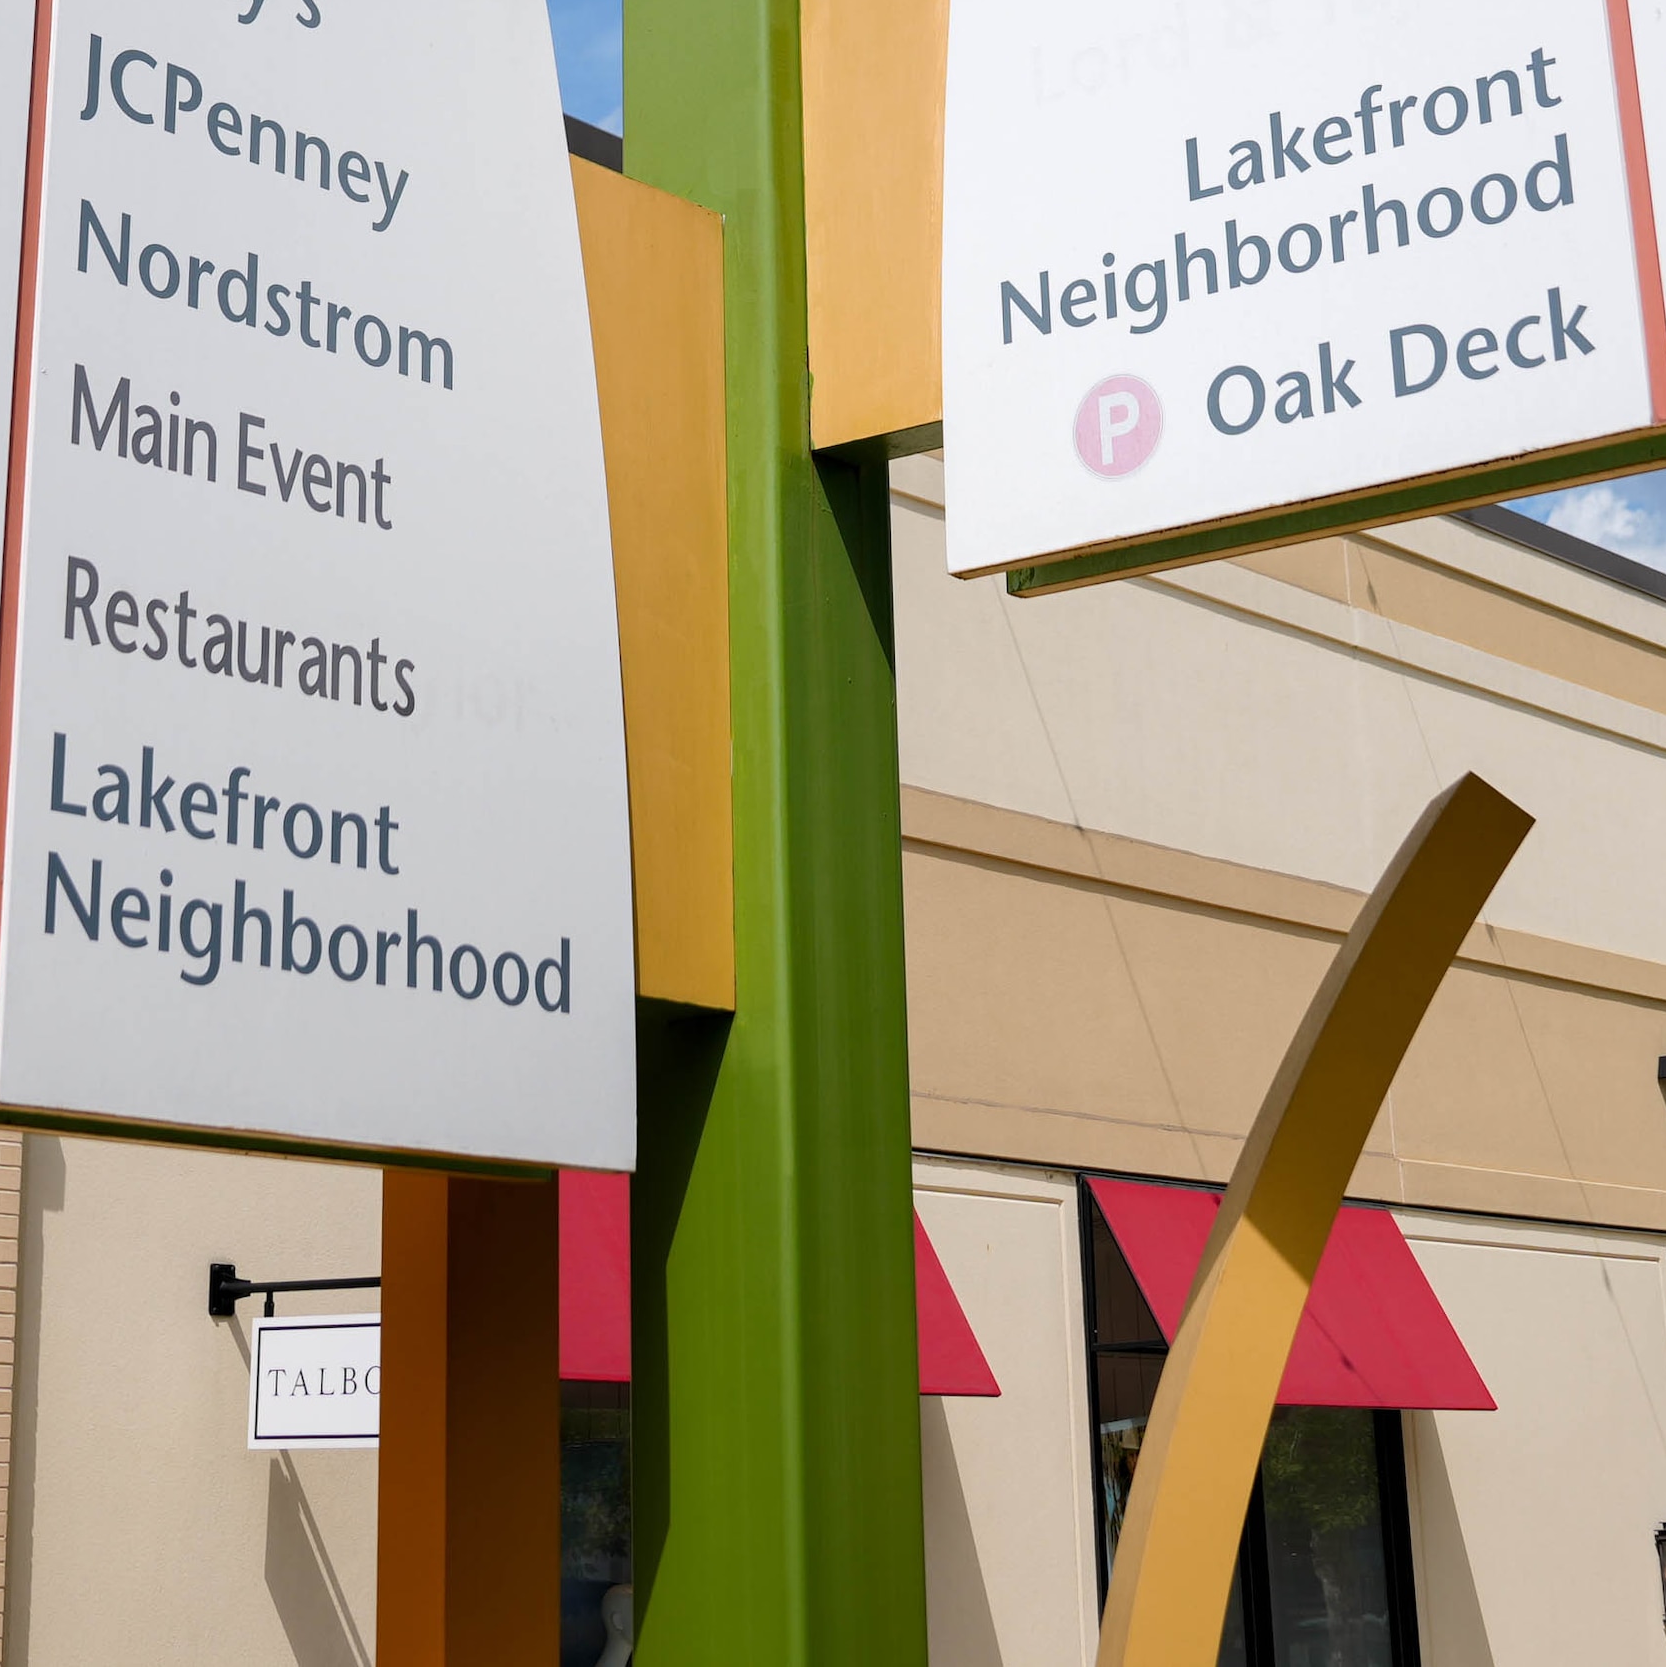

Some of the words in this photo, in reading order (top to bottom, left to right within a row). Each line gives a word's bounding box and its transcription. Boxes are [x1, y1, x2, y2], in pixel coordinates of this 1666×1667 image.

[79, 33, 410, 233] JCPenney
[1185, 46, 1563, 202] Lakefront
[77, 198, 454, 391] Nordstrom
[1000, 132, 1575, 345] Neighborhood
[70, 363, 217, 482] Main
[236, 413, 393, 531] Event
[1099, 391, 1140, 465] P
[1206, 340, 1363, 436] Oak
[1389, 286, 1596, 399] Deck
[64, 555, 416, 718] Restaurants
[50, 731, 400, 876] Lakefront
[44, 850, 571, 1015] Neighborhood
